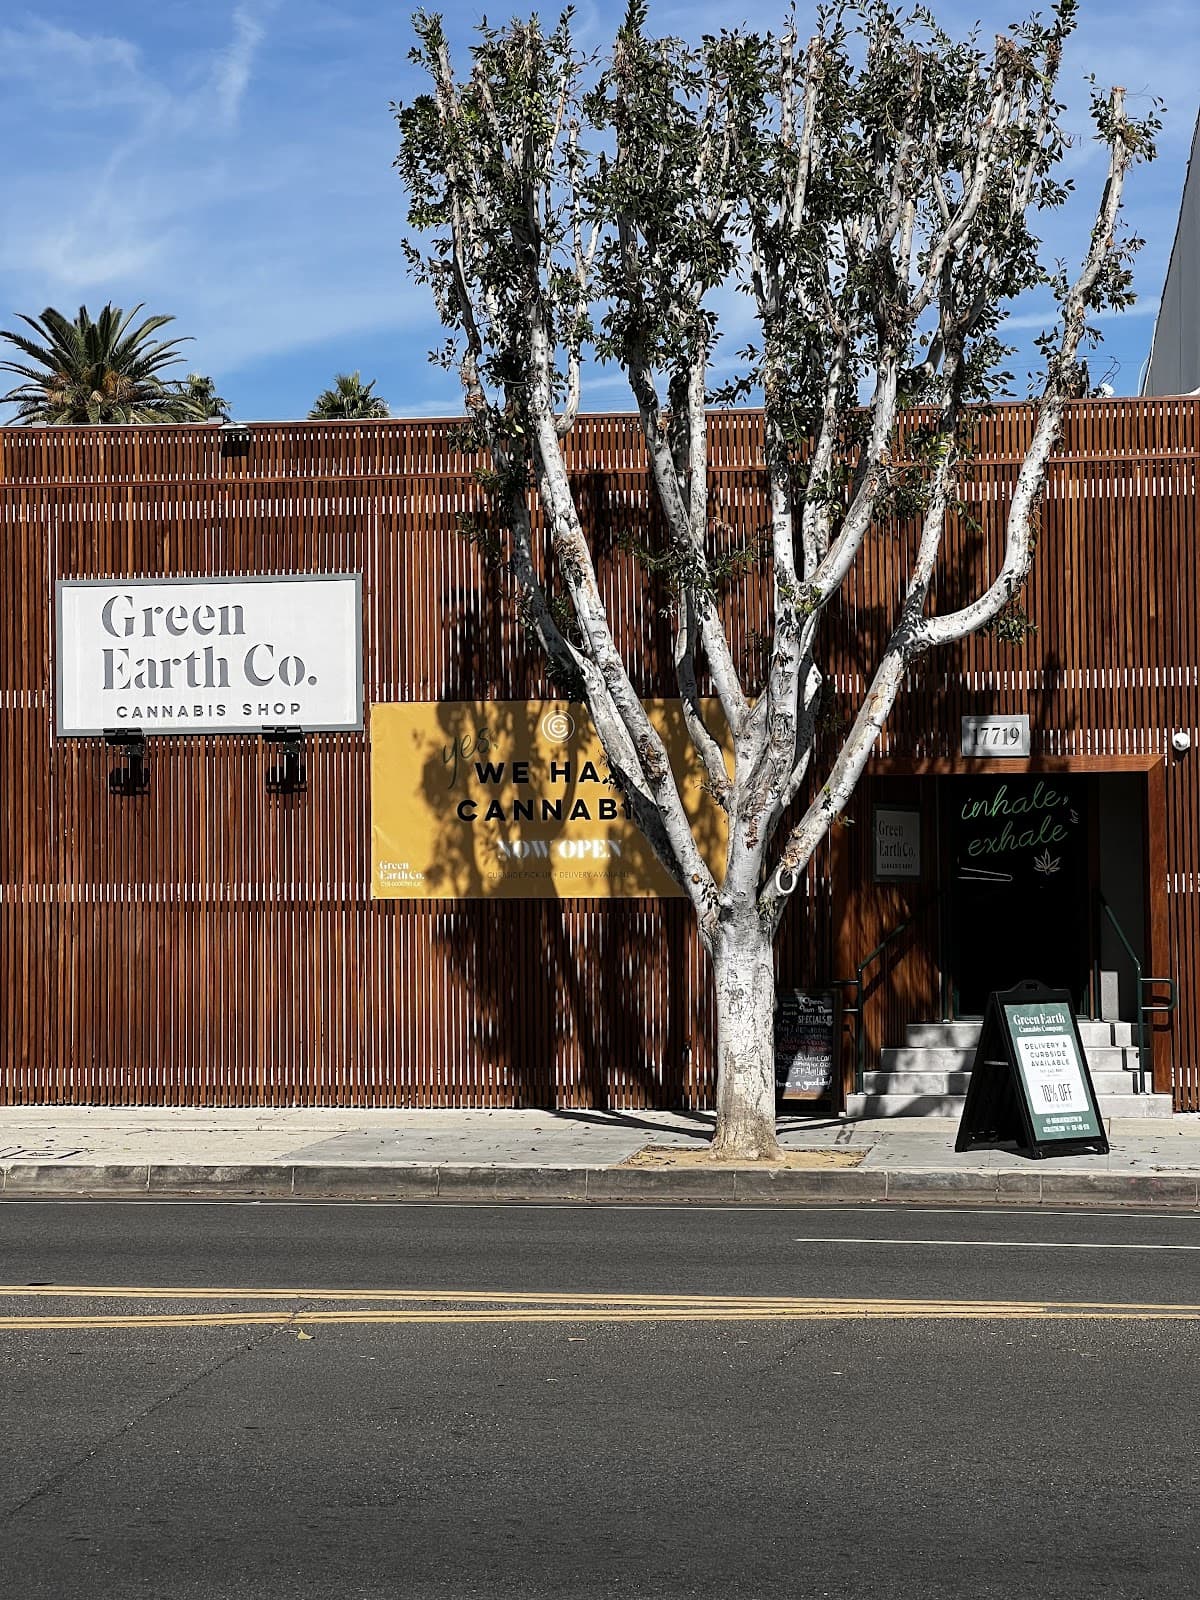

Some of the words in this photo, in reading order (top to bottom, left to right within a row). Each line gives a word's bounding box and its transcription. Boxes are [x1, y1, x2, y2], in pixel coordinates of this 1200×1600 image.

[101, 594, 247, 638] Green
[102, 646, 232, 690] Earth
[243, 643, 318, 687] Co.
[116, 704, 226, 719] CANNABIS
[242, 702, 302, 716] SHOP
[972, 726, 1020, 745] 17719
[474, 762, 529, 784] WE
[551, 761, 601, 783] HA
[457, 798, 633, 821] CANNABI
[878, 820, 903, 836] Green
[968, 814, 1068, 856] exhale
[498, 840, 551, 858] NOW
[559, 839, 622, 858] OPEN
[880, 840, 902, 857] Earth
[379, 860, 409, 869] Green
[380, 870, 408, 880] Earth
[408, 871, 425, 880] Co.
[560, 871, 592, 879] DELIVERY
[1013, 1014, 1040, 1025] Green
[1040, 1012, 1066, 1024] Earth
[1025, 1042, 1059, 1050] DELIVERY
[1030, 1050, 1067, 1058] CURBSIDE
[1031, 1059, 1070, 1067] AVAILABLE
[1040, 1084, 1059, 1103] 10%
[1057, 1083, 1073, 1102] OFF
